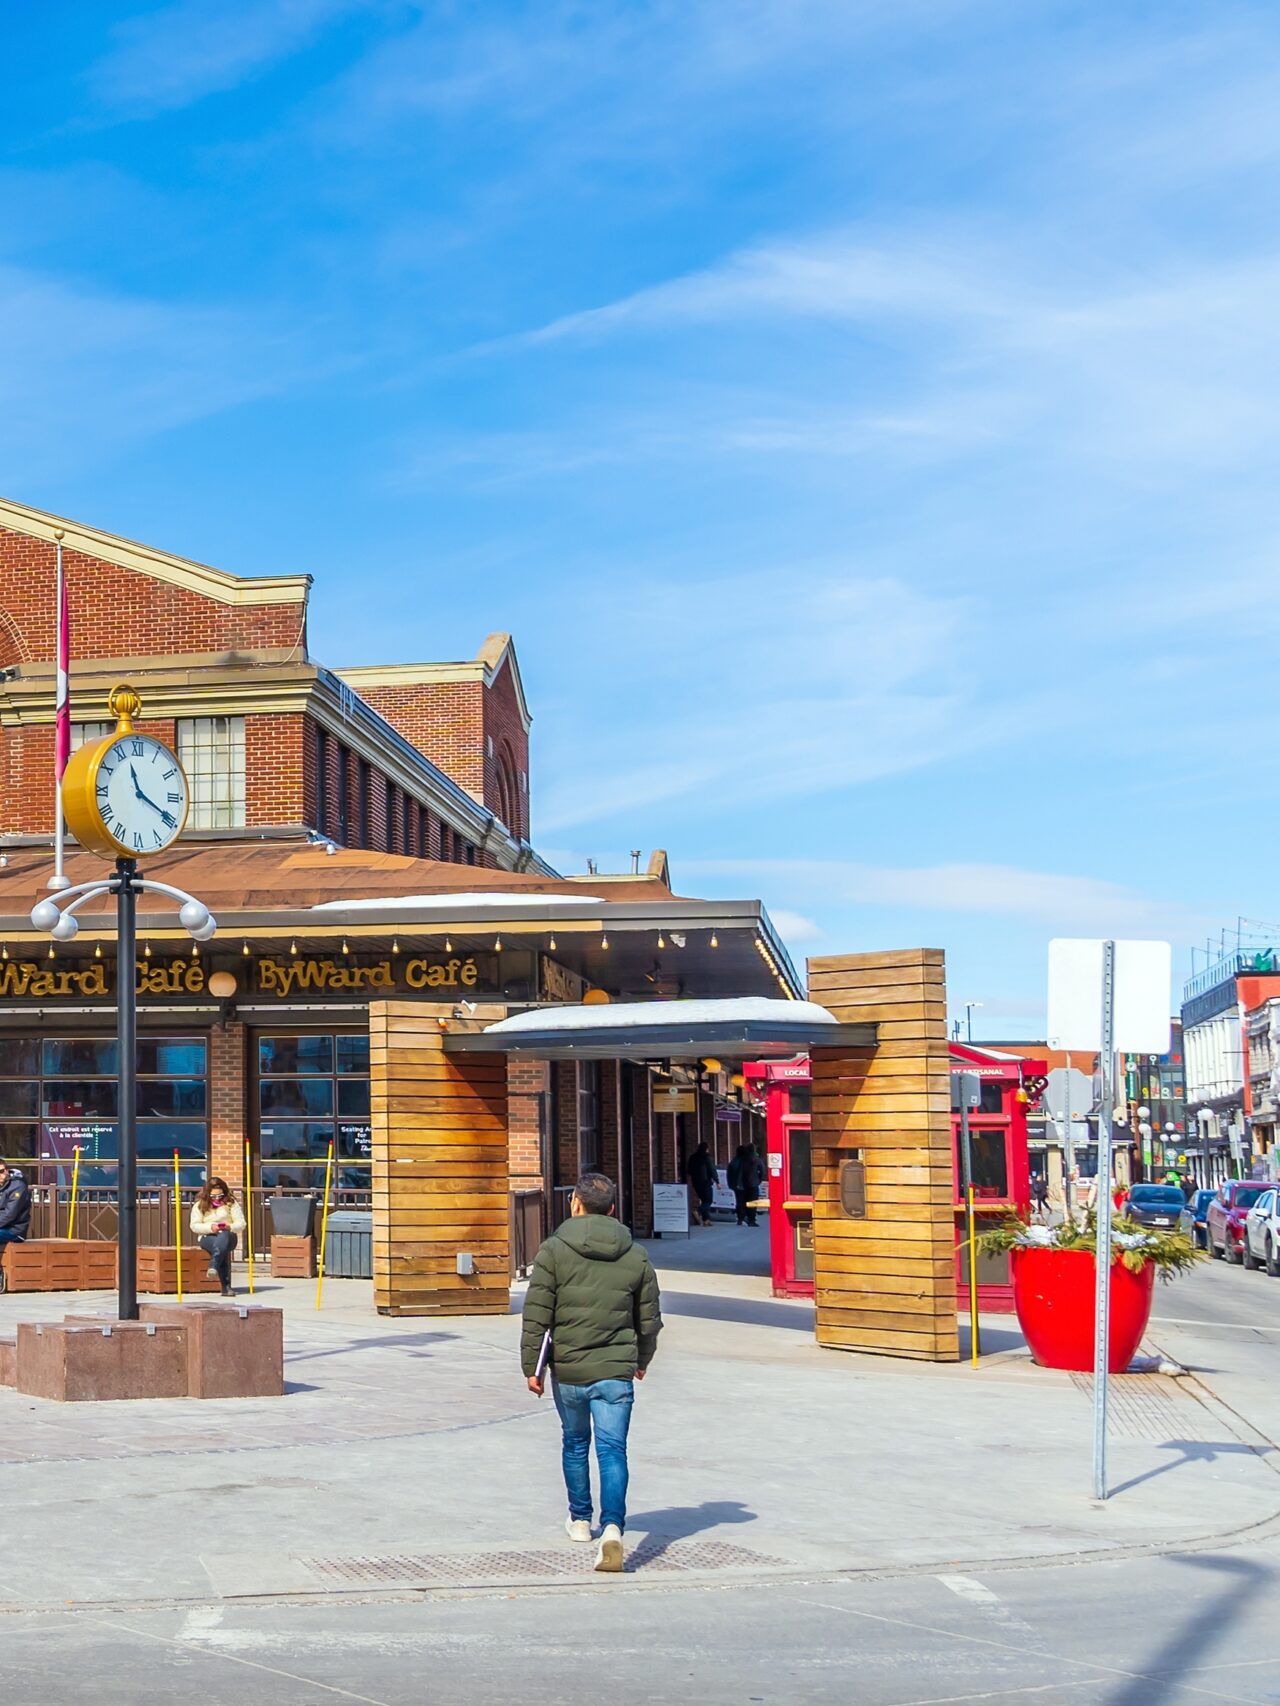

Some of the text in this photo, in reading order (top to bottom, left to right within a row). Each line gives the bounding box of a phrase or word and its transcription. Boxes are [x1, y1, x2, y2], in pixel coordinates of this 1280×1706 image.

[113, 744, 127, 762] XI
[131, 740, 144, 757] XII
[152, 750, 159, 764] I
[100, 761, 114, 776] X
[162, 769, 175, 781] II
[96, 784, 108, 797] IX
[167, 792, 179, 803] III
[99, 803, 114, 825] VIII
[112, 822, 126, 842] VII
[152, 829, 162, 843] V
[133, 832, 144, 848] VI
[259, 958, 478, 997] ByWard Café
